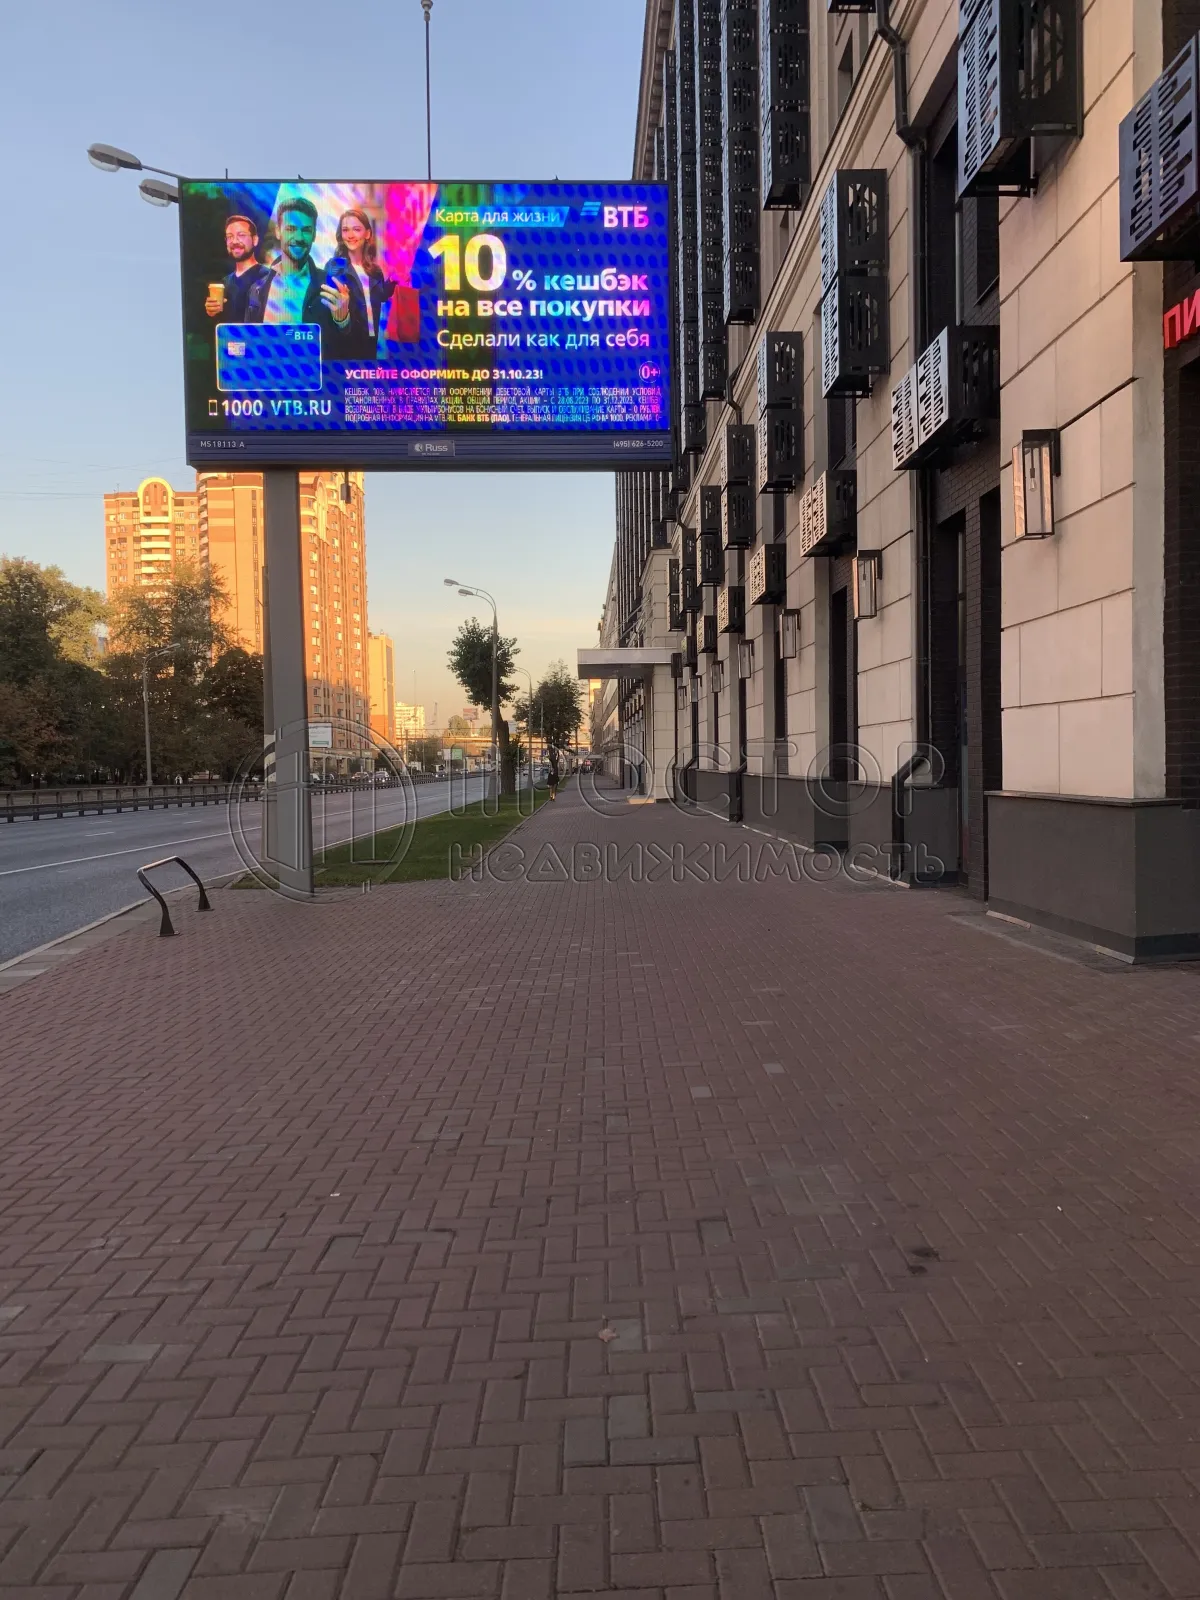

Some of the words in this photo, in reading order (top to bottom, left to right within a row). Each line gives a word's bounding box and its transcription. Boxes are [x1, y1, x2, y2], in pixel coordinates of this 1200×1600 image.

[435, 209, 479, 225] Карта
[482, 211, 508, 224] для
[512, 211, 560, 222] жизни
[603, 206, 649, 228] ВТБ
[544, 267, 649, 291] кешбэк
[437, 300, 470, 316] на
[477, 300, 523, 316] все
[529, 300, 650, 321] покупки
[294, 331, 314, 341] ВТБ
[436, 329, 520, 349] Сделали
[527, 333, 560, 347] как
[565, 333, 599, 349] для
[605, 328, 650, 347] себя
[345, 367, 398, 379] УСПЕЙТЕ
[400, 369, 470, 380] ОФОРМИТЬ
[472, 369, 490, 381] ДО
[492, 369, 544, 379] 31.10.23!
[641, 366, 659, 379] 0+
[222, 400, 263, 416] 1000
[270, 400, 332, 416] VTB.RU
[457, 414, 475, 422] БАНК
[477, 414, 489, 422] ВТБ
[425, 443, 448, 452] Russ
[613, 440, 630, 448] (495)
